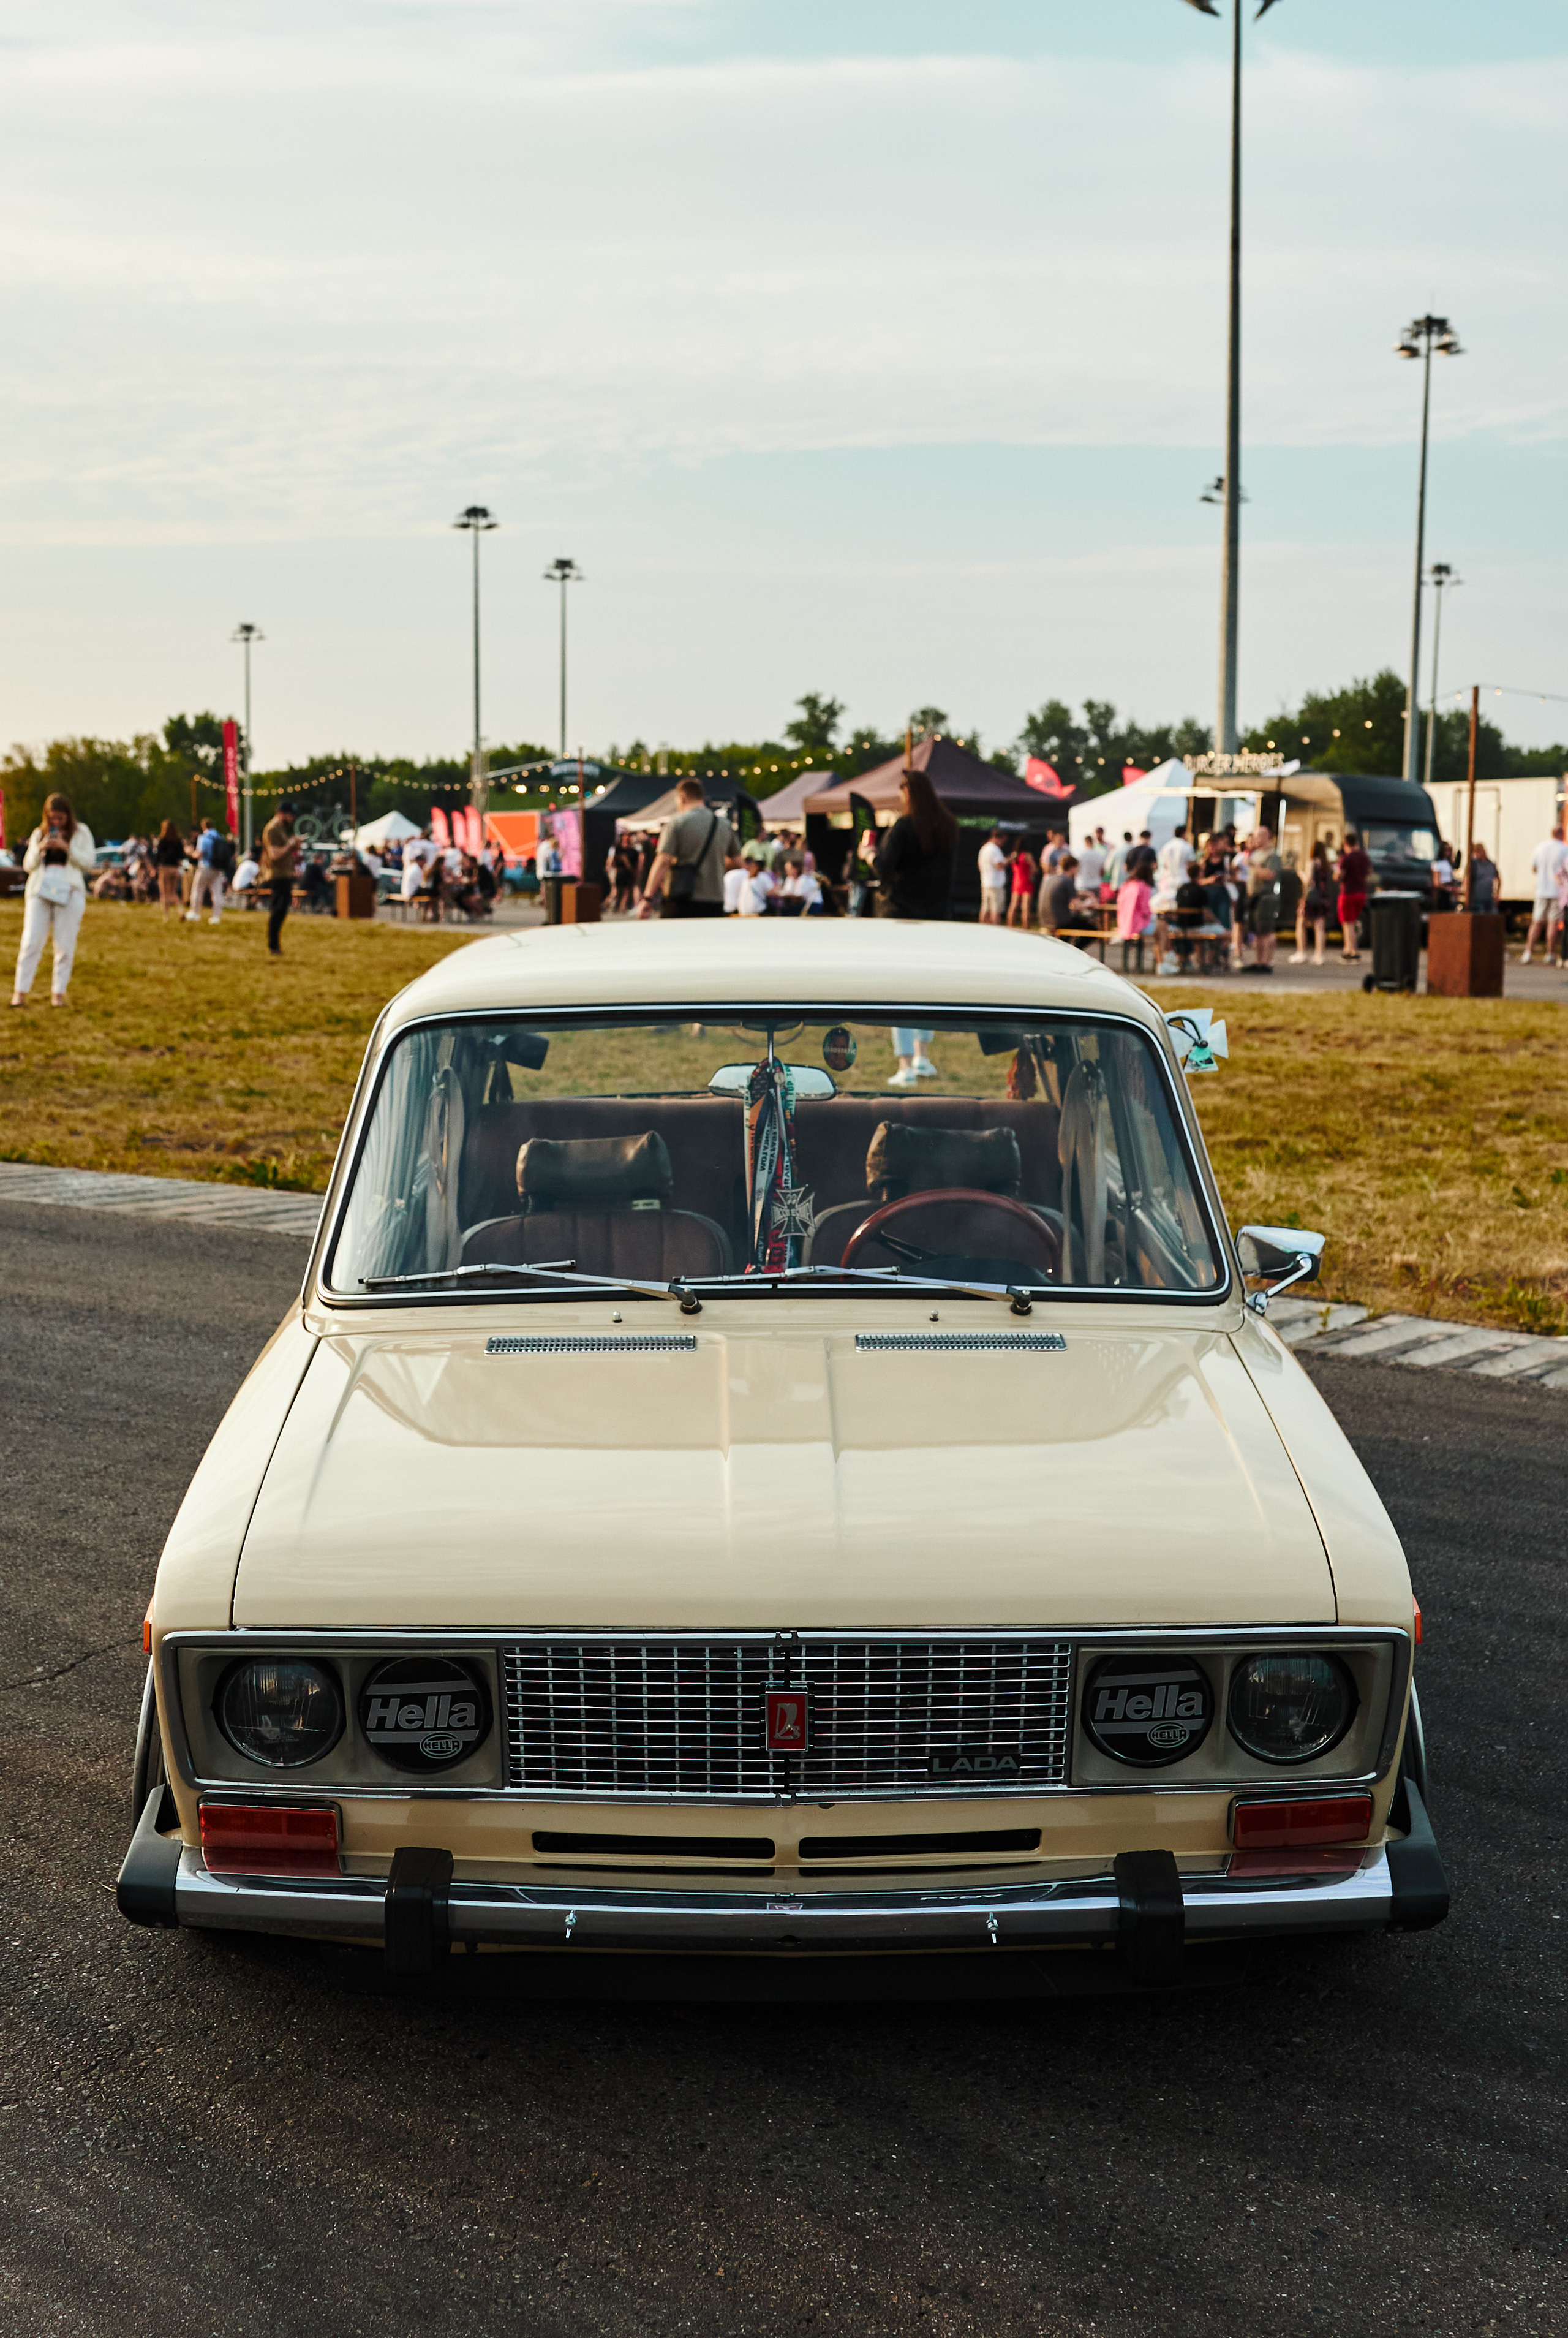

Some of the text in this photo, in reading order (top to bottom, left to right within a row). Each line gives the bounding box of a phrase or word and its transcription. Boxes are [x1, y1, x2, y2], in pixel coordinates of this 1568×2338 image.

[1094, 1685, 1203, 1720] Hella
[366, 1695, 476, 1730] Hella
[1152, 1728, 1187, 1741] HELLA
[423, 1739, 459, 1751] HELLA
[932, 1756, 1019, 1772] LADA
